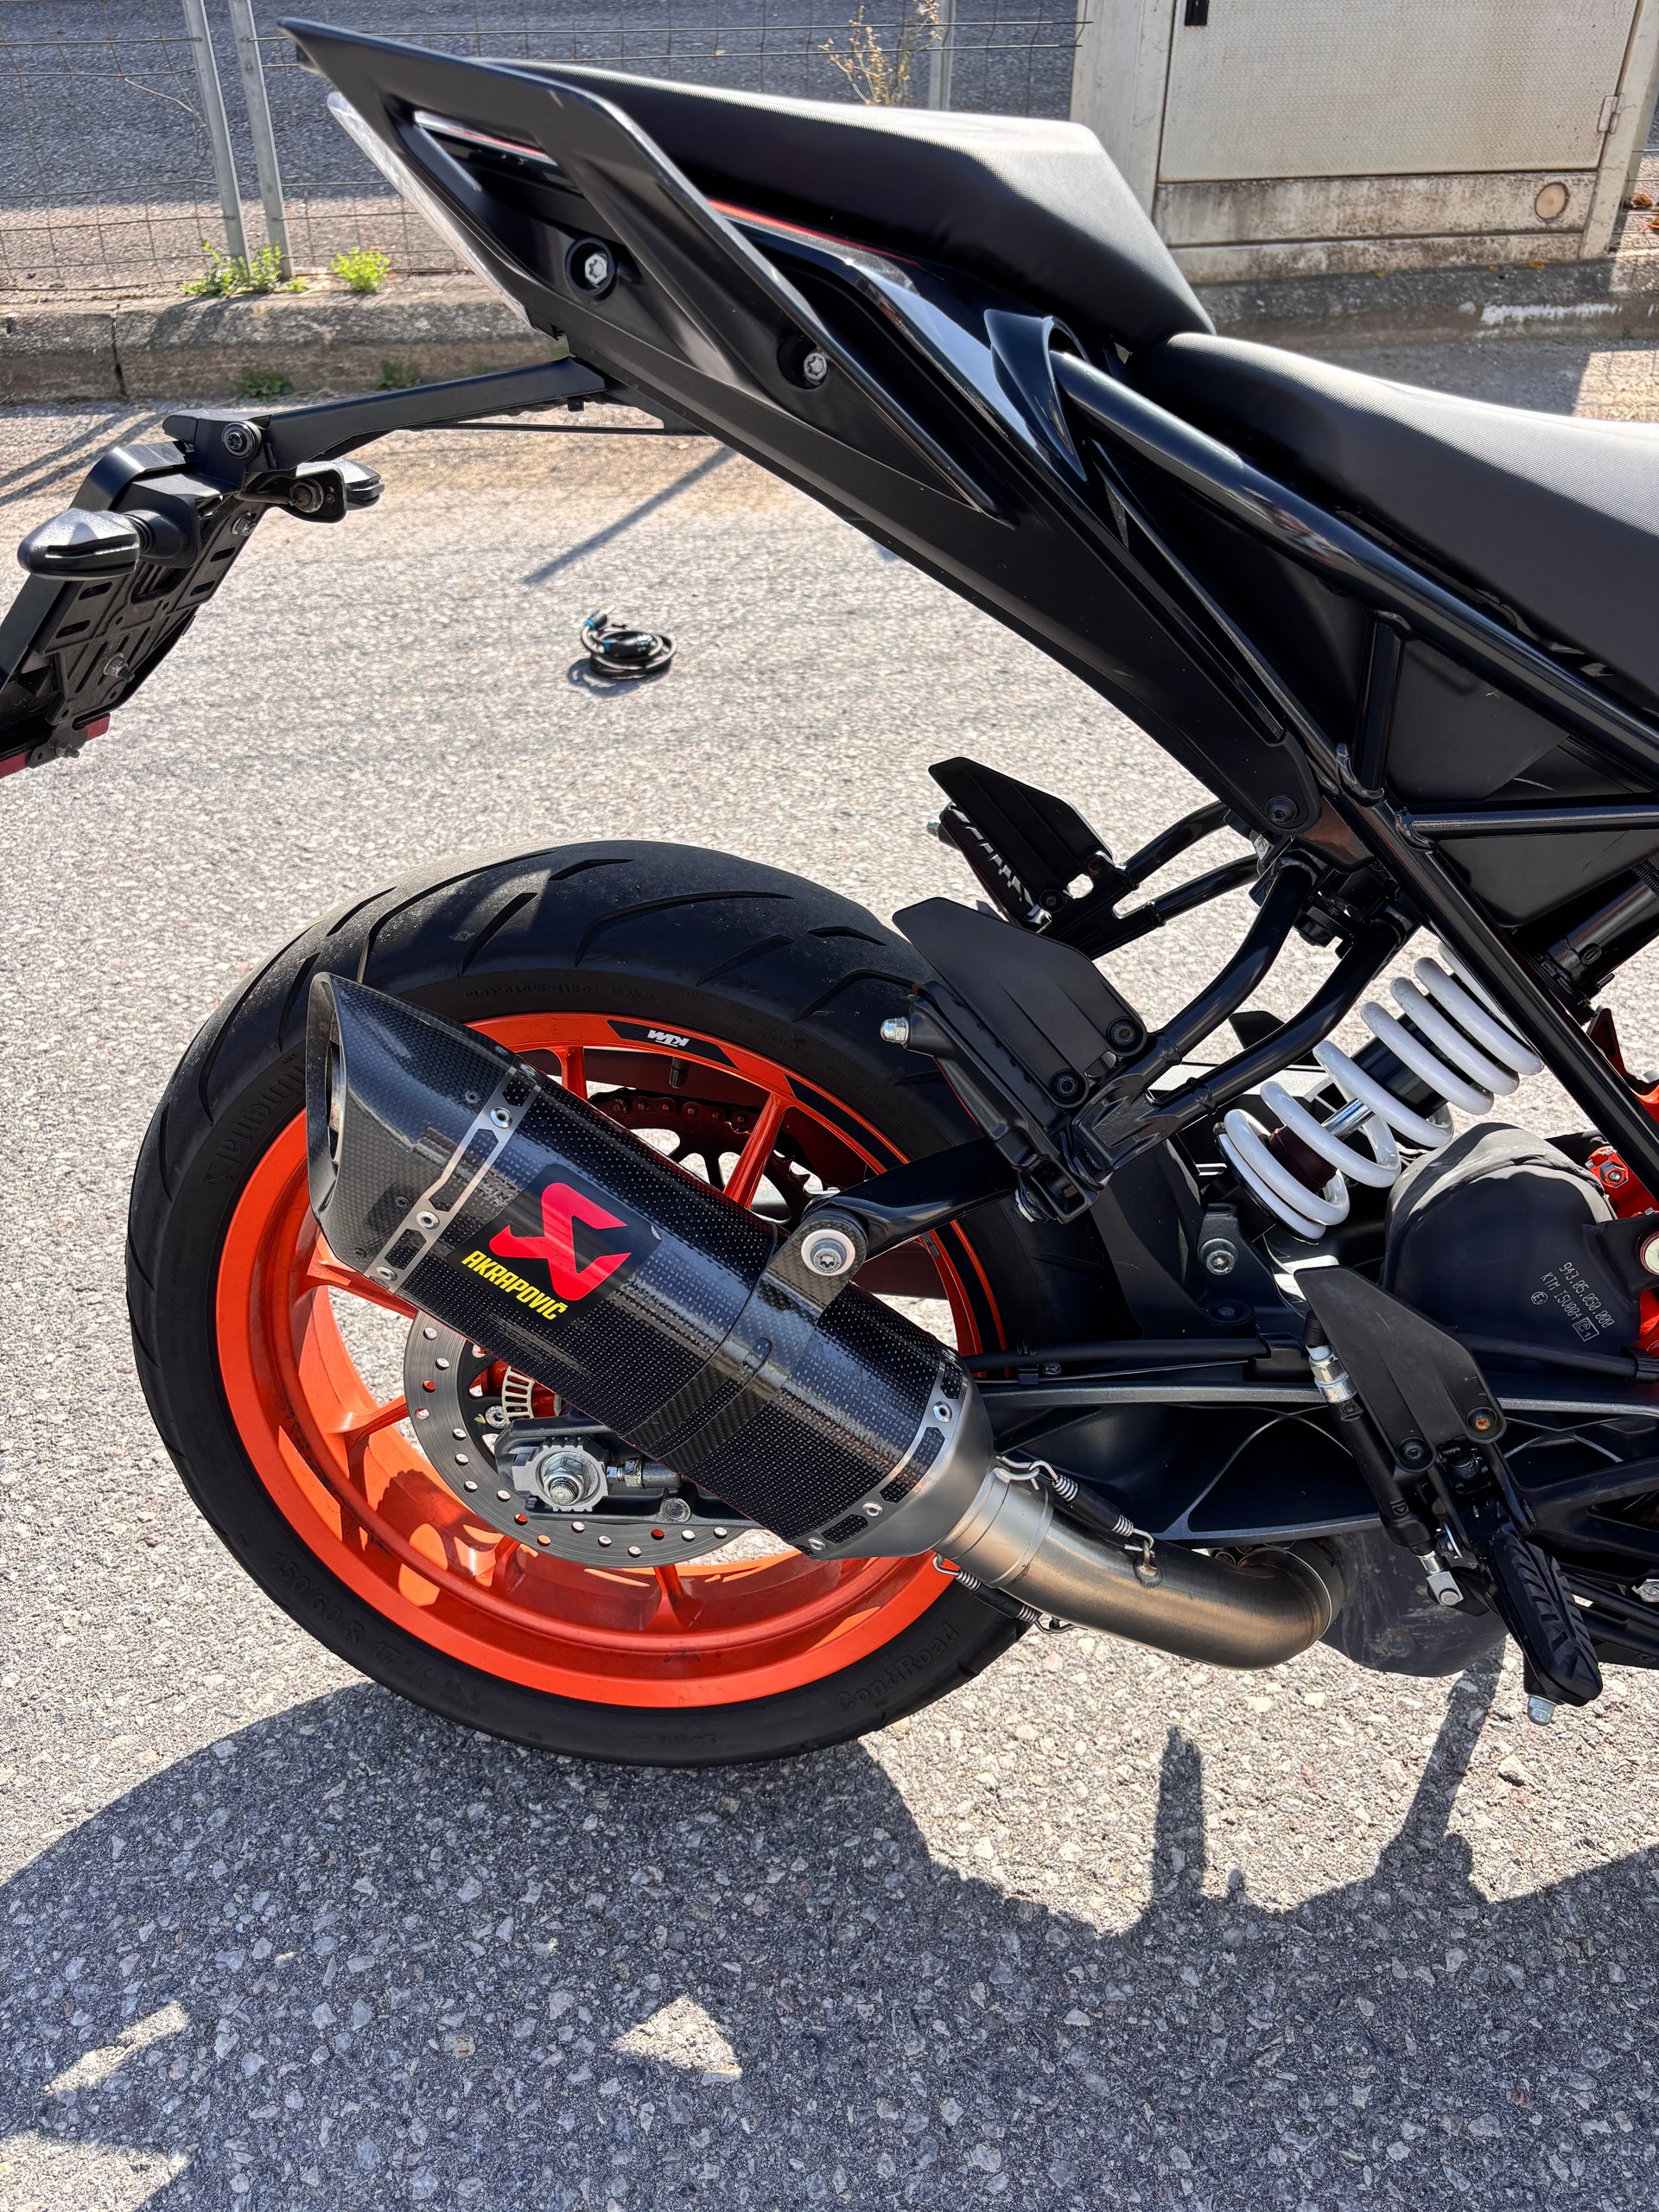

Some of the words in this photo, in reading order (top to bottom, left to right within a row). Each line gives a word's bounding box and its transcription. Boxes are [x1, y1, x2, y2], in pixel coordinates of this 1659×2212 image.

[646, 1029, 690, 1047] KTM
[461, 1249, 569, 1320] AKRAPOVIČ
[1540, 1271, 1561, 1292] KTM
[1559, 1262, 1615, 1328] 943.05.050.000
[268, 1551, 344, 1623] 150/60
[370, 1640, 403, 1667] 17
[836, 1620, 961, 1711] ContiRoad
